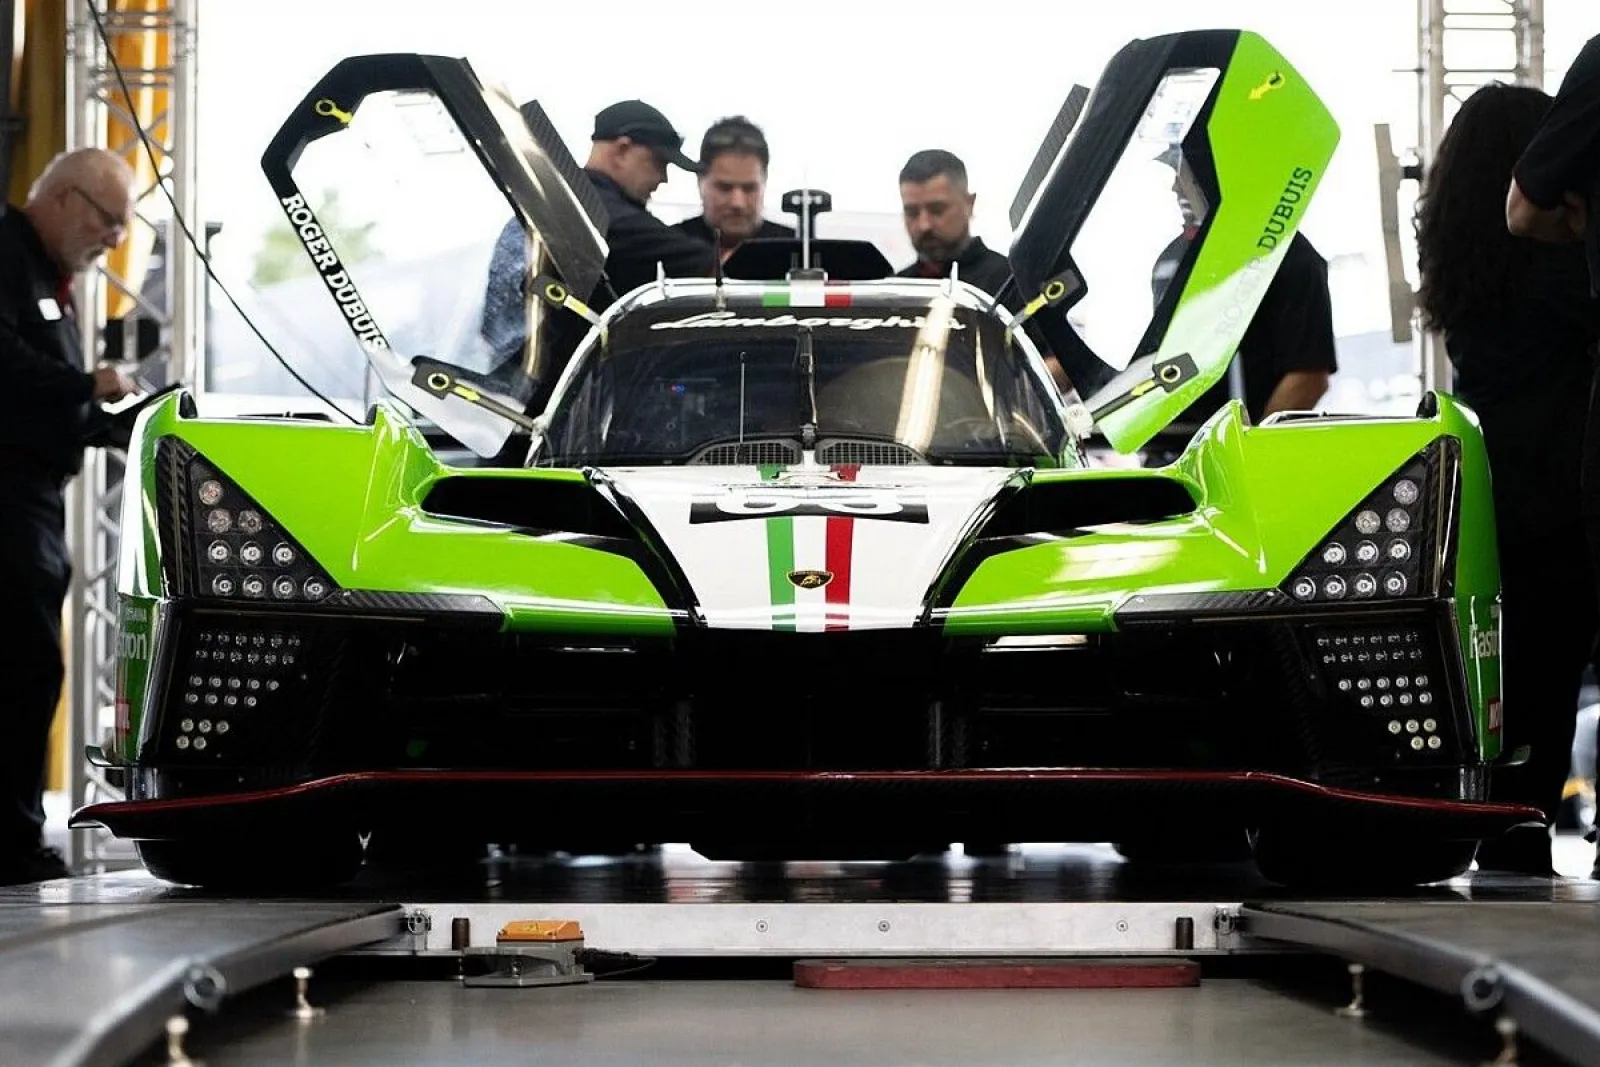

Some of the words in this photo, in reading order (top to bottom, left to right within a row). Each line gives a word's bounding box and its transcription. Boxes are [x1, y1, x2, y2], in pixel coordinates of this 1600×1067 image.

[1257, 167, 1313, 252] DUBUIS
[282, 192, 337, 271] ROGER
[325, 269, 390, 352] DUBUIS
